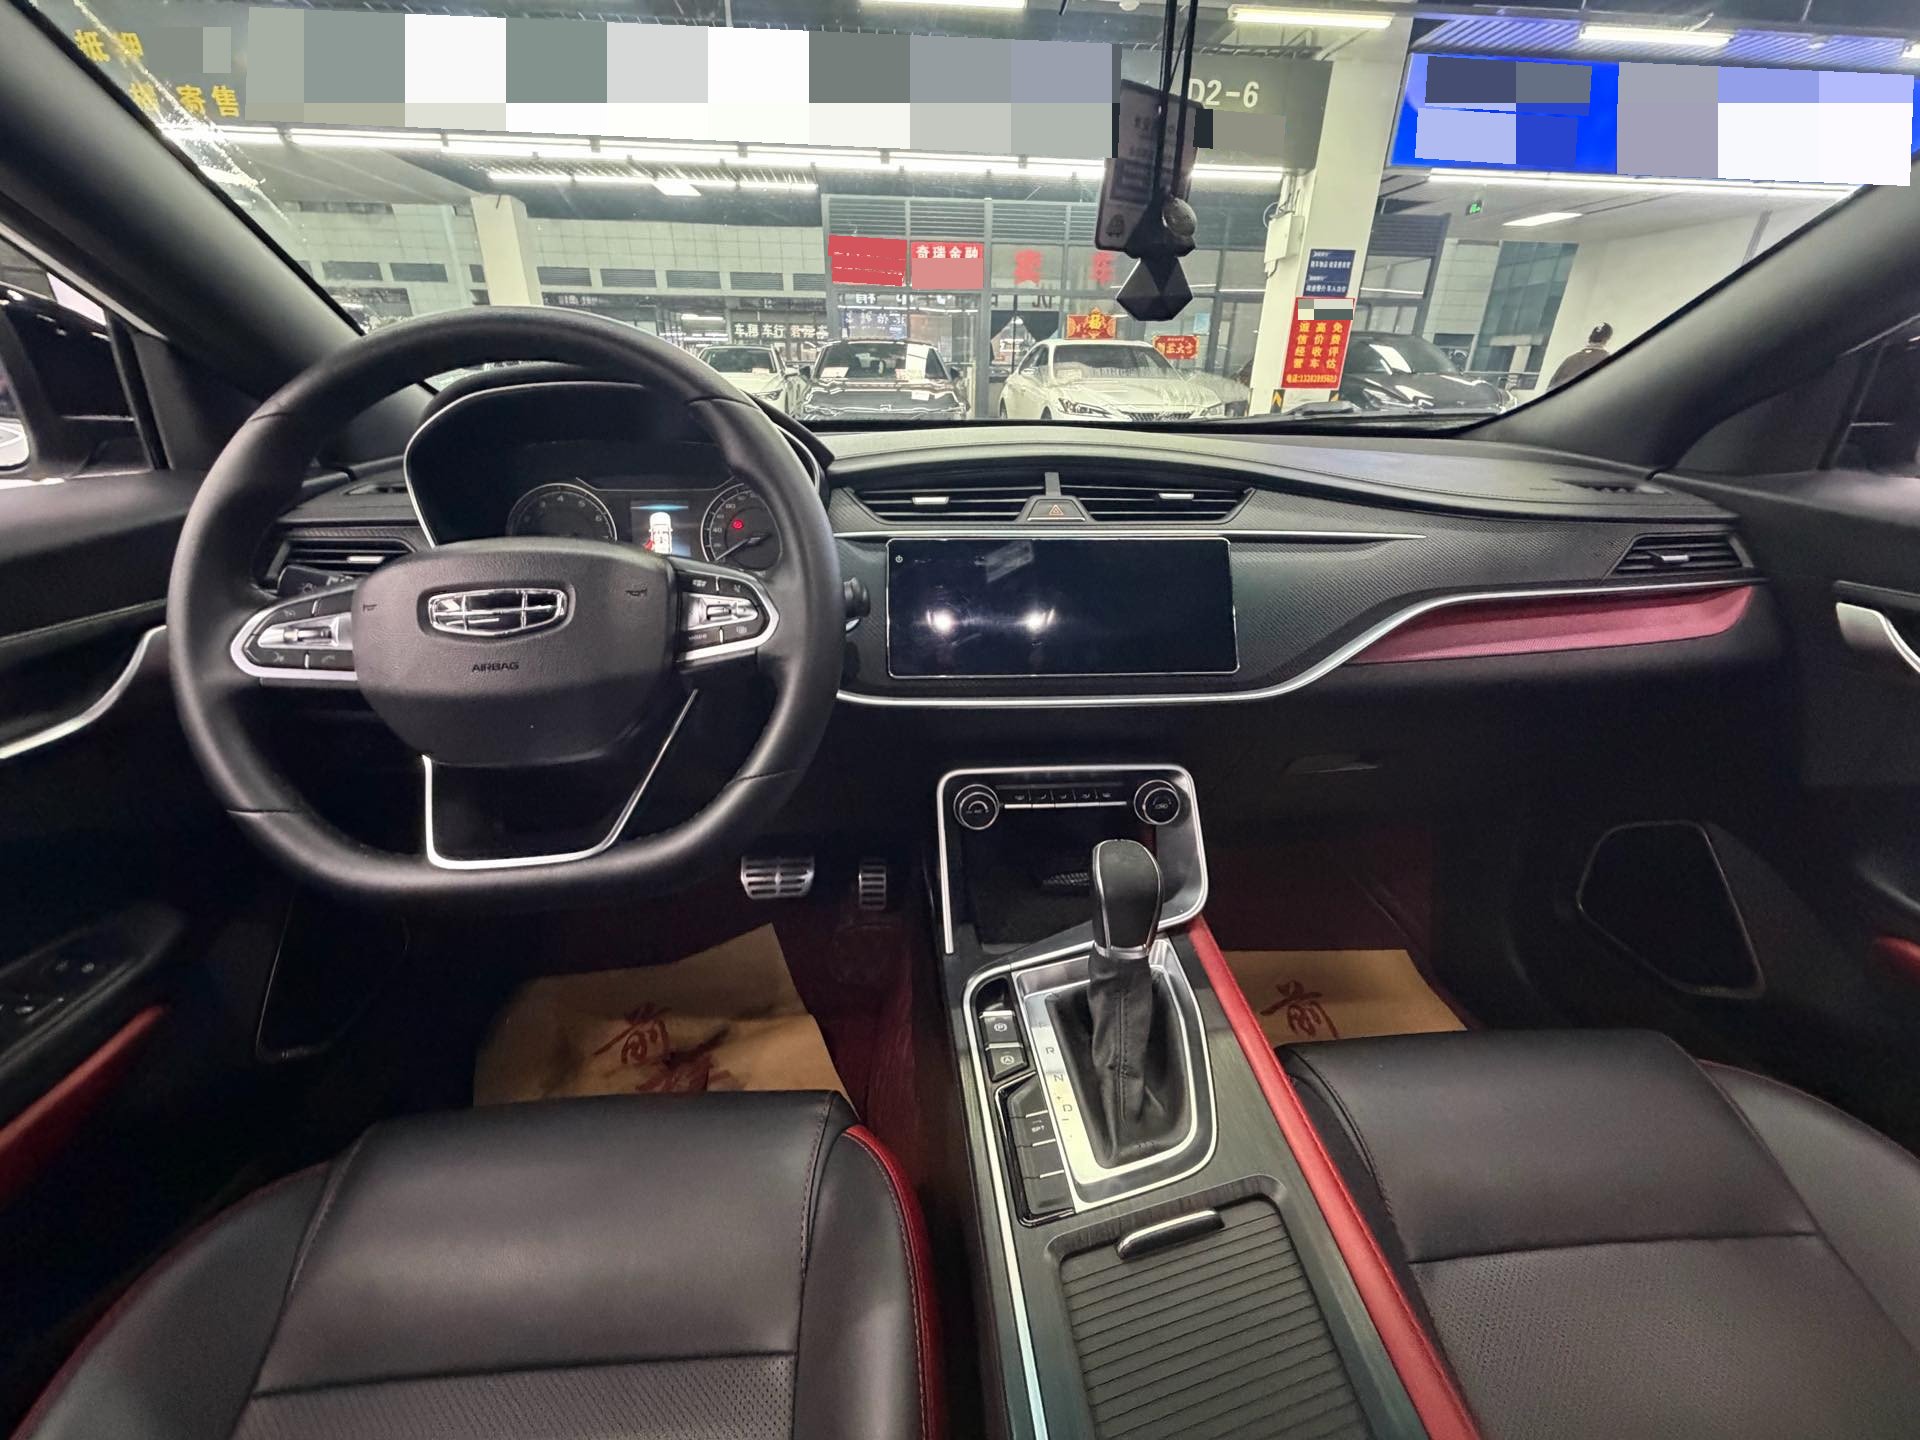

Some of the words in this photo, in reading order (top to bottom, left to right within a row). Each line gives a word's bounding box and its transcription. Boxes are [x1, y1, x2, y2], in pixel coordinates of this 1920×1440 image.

[1188, 79, 1260, 108] D2-6
[1309, 321, 1327, 369] 高价收车
[1325, 321, 1344, 369] 免费评估
[472, 661, 520, 672] AIRBAG
[1045, 1046, 1055, 1055] R
